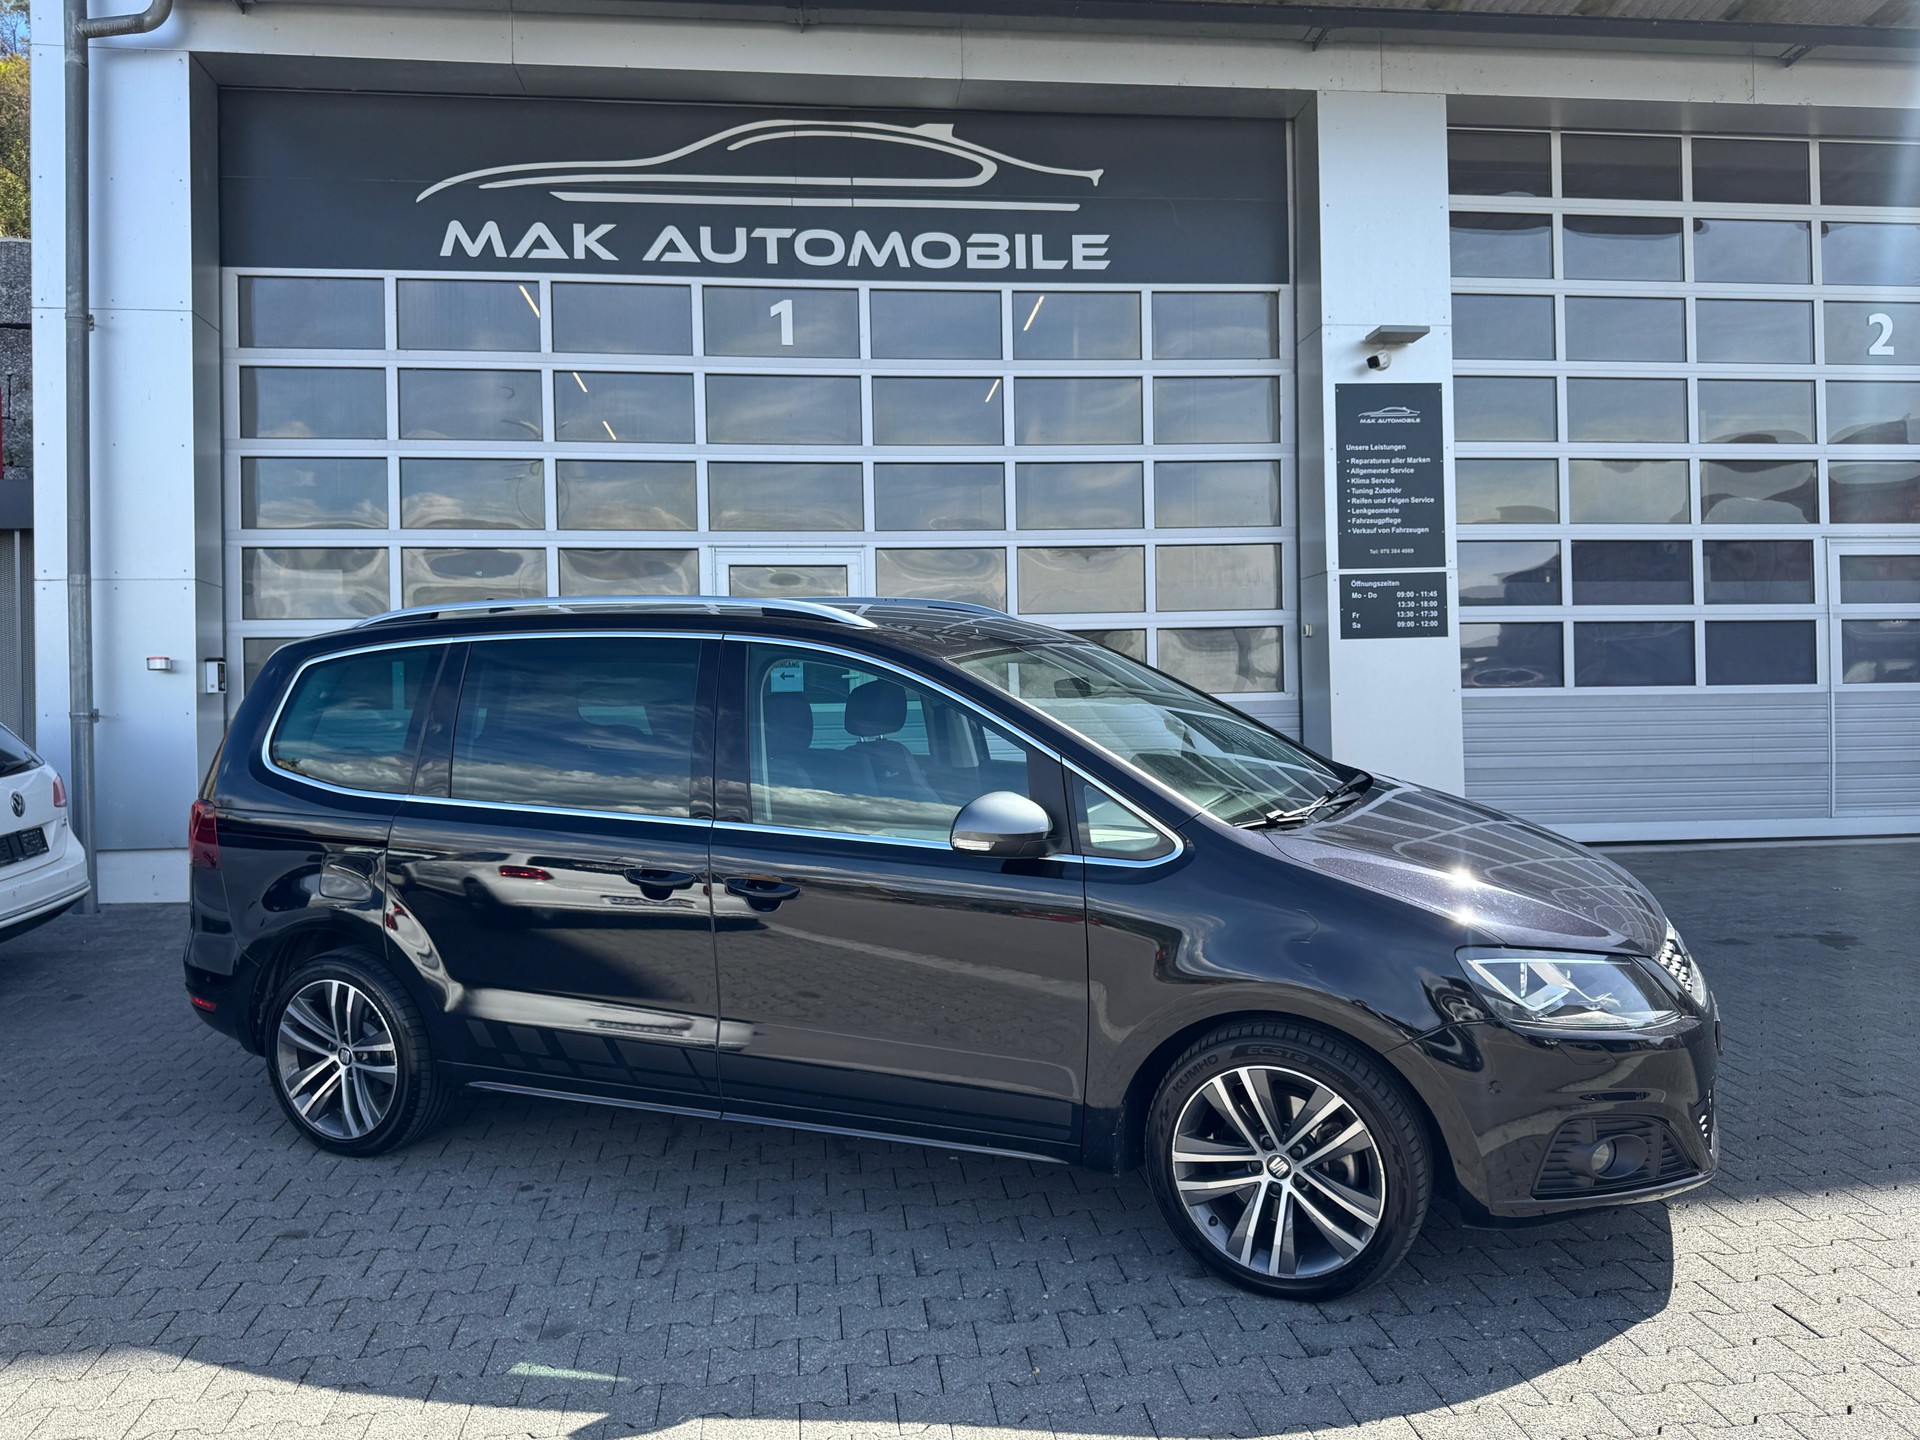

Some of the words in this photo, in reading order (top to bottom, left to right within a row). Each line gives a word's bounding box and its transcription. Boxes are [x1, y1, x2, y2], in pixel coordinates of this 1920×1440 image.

[439, 219, 620, 261] MAK
[641, 225, 1111, 270] AUTOMOBILE
[769, 299, 794, 346] 1
[1868, 312, 1895, 356] 2
[1369, 443, 1407, 452] Leistungen
[1350, 457, 1391, 466] Reparaturen
[1406, 456, 1431, 464] Marken
[1350, 467, 1390, 476] Allgemeiner
[1390, 466, 1415, 474] Service
[1350, 477, 1370, 485] Klima
[1370, 477, 1396, 485] Service
[1350, 487, 1374, 496] Tuning
[1374, 486, 1402, 494] Zubehör
[1351, 497, 1373, 505] Reifen
[1387, 496, 1410, 505] Felgen
[1410, 496, 1435, 504] Service
[1351, 506, 1400, 516] Lenkgeometrie
[1351, 516, 1402, 526] Fahrzeugpflege
[1351, 526, 1378, 535] Verkauf
[1391, 526, 1430, 535] Fahrzeugen
[1350, 579, 1400, 588] Öffnungszeiten
[1367, 591, 1378, 599] Do
[1396, 590, 1415, 598] 09:00
[1420, 590, 1438, 598] 11:45
[1397, 600, 1416, 608] 13:30
[1420, 600, 1438, 608] 18:00
[1351, 611, 1360, 619] Fr
[1396, 610, 1415, 618] 13:30
[1420, 610, 1439, 618] 17:30
[1351, 621, 1361, 629] Sa
[1396, 620, 1415, 628] 09:00
[1420, 620, 1439, 628] 12:00
[1172, 1053, 1219, 1094] KUMHO
